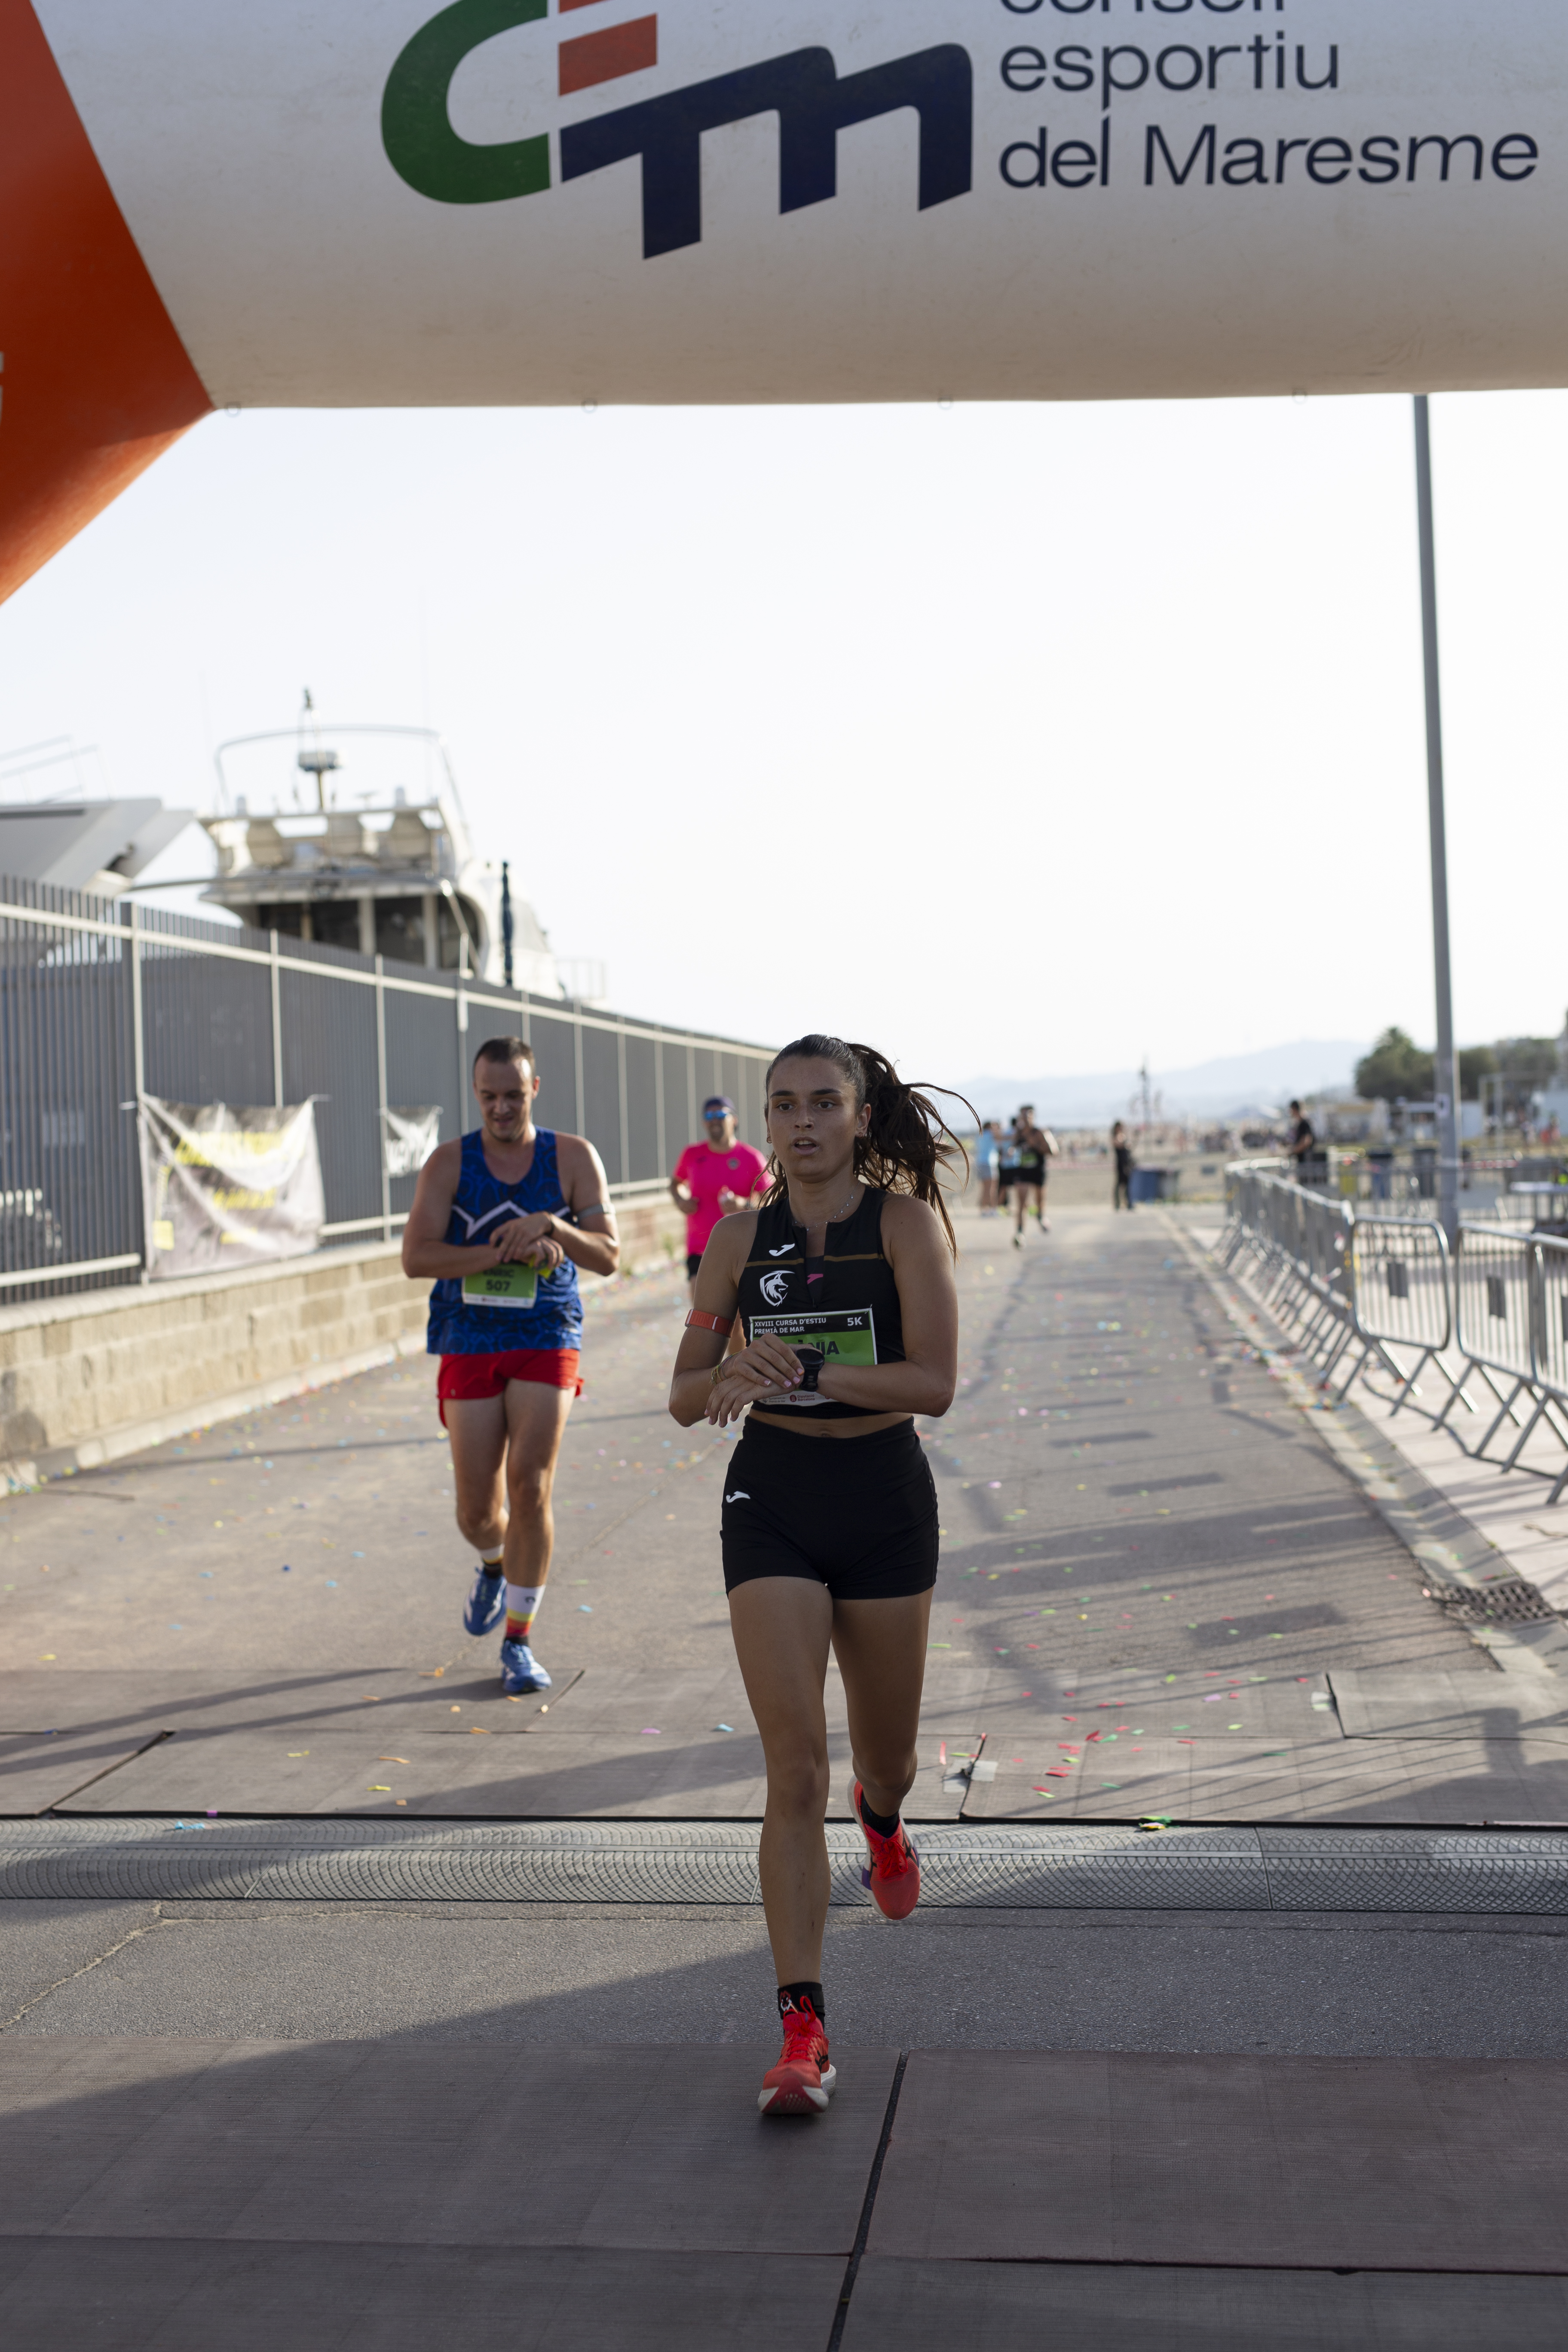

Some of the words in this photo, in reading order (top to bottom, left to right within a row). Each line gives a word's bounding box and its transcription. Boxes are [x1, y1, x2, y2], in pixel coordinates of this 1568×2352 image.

[1000, 30, 1338, 110] esportiu
[999, 116, 1110, 189] del
[1145, 124, 1538, 186] Maresme
[486, 1279, 511, 1292] 507
[847, 1317, 863, 1326] 5K
